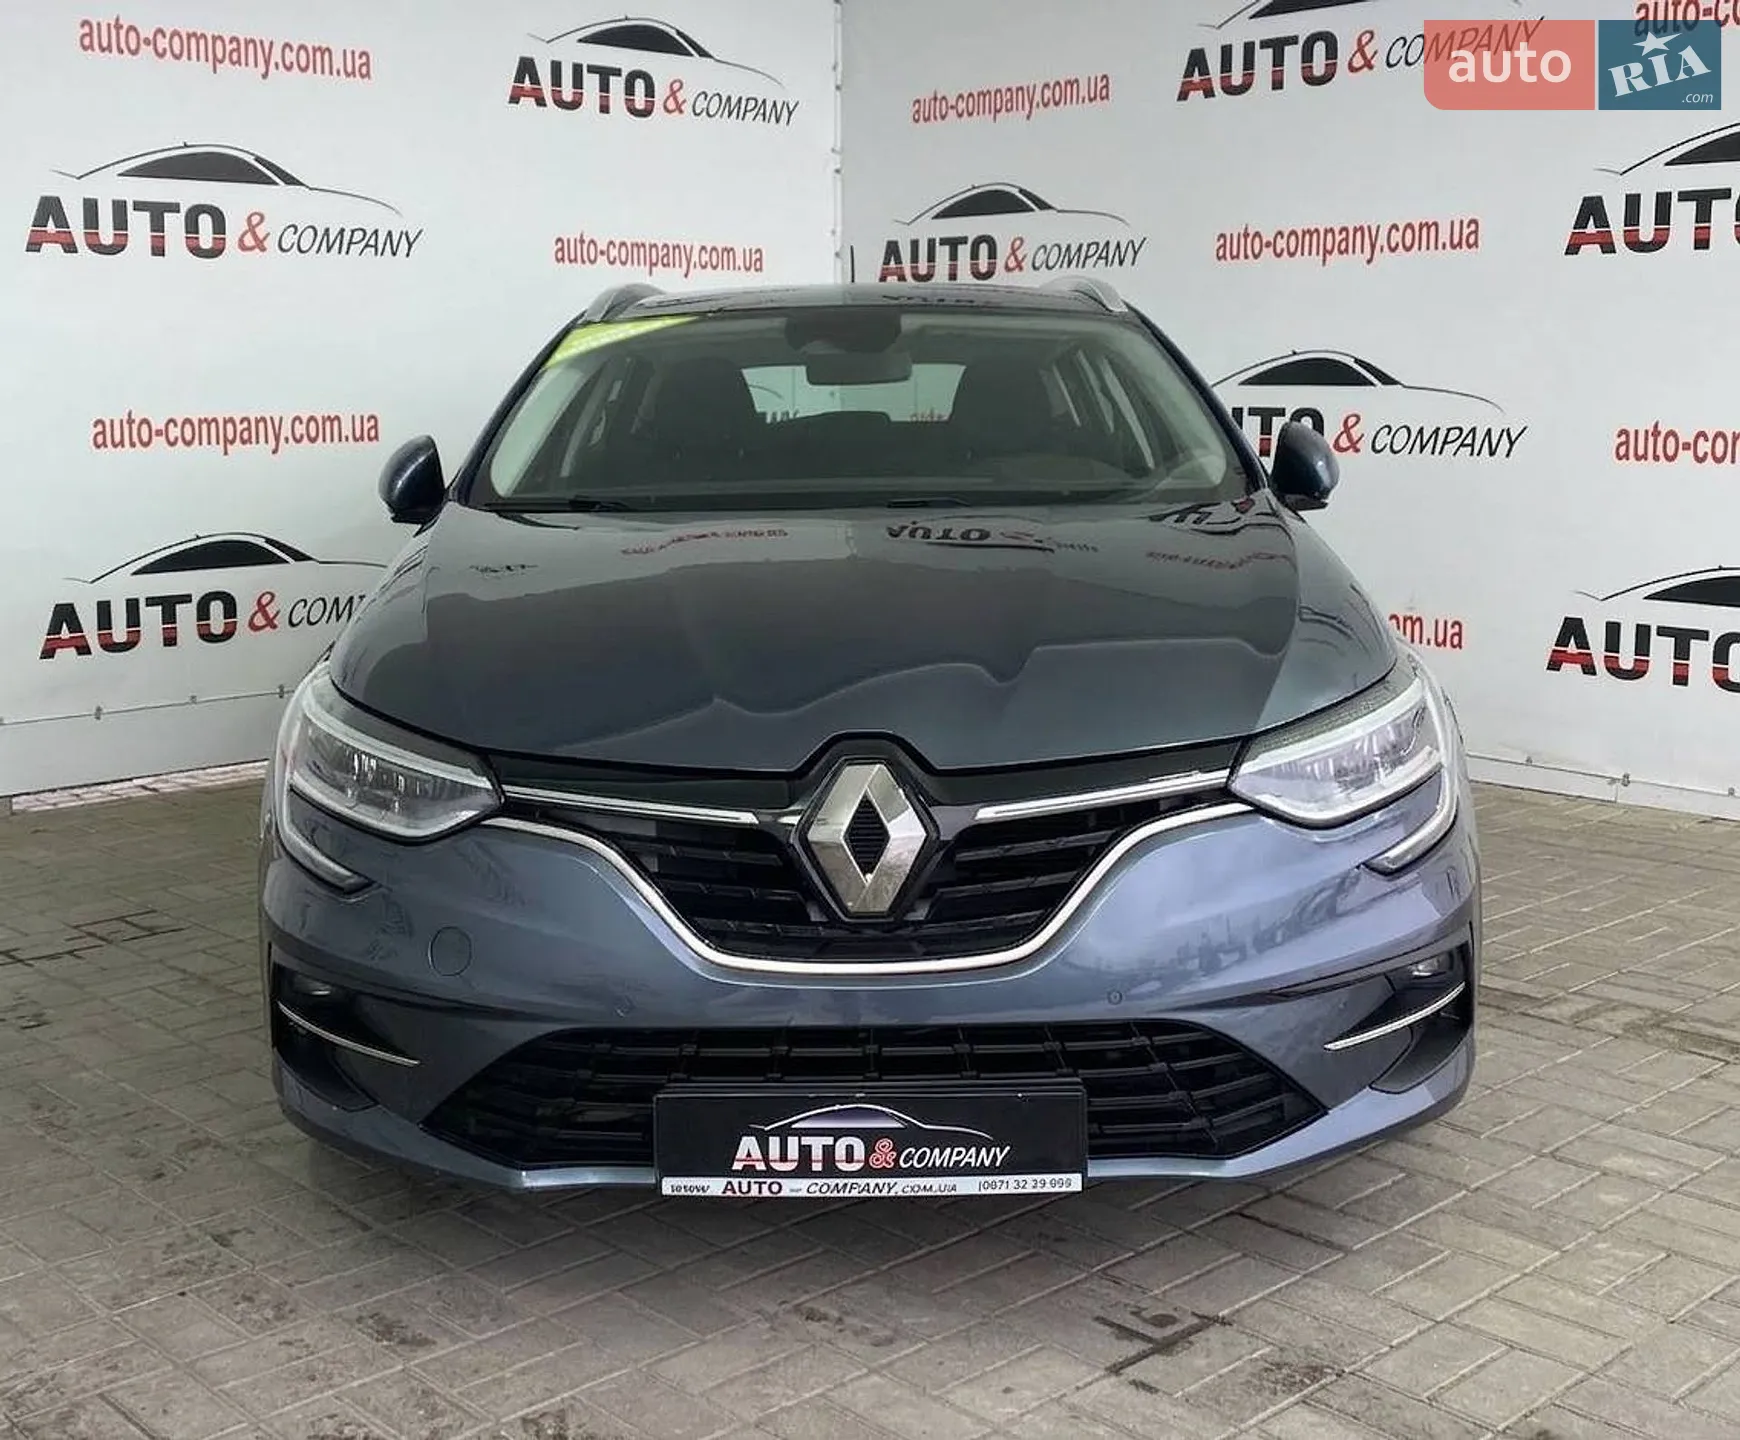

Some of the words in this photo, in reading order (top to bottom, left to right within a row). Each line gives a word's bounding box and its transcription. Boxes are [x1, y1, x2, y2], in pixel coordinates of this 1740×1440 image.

[79, 16, 371, 79] auto-company.com.ua
[1177, 30, 1338, 101] AUTO
[1347, 30, 1378, 74] &
[1385, 16, 1545, 69] COMPANY
[508, 55, 656, 118] AUTO
[663, 78, 686, 115] &
[691, 91, 799, 126] COMPANY
[912, 73, 1110, 123] auto-company.com.ua
[25, 195, 227, 259] AUTO
[237, 211, 271, 253] &
[277, 224, 424, 258] COMPANY
[1215, 218, 1480, 267] auto-company.com.ua
[1564, 187, 1740, 256] AUT
[554, 233, 763, 279] auto-company.com.ua
[878, 234, 998, 282] AUTO
[1004, 236, 1027, 273] &
[1031, 236, 1147, 272] COMPANY
[92, 410, 379, 456] auto-company.com.ua
[1333, 413, 1363, 453] &
[1371, 424, 1528, 459] COMPANY
[39, 591, 238, 660] AUTO
[248, 591, 281, 633] &
[288, 594, 366, 628] COM
[731, 1136, 865, 1172] AUTO
[868, 1138, 897, 1169] &
[899, 1145, 1010, 1168] COMPANY
[721, 1180, 783, 1195] AUTO
